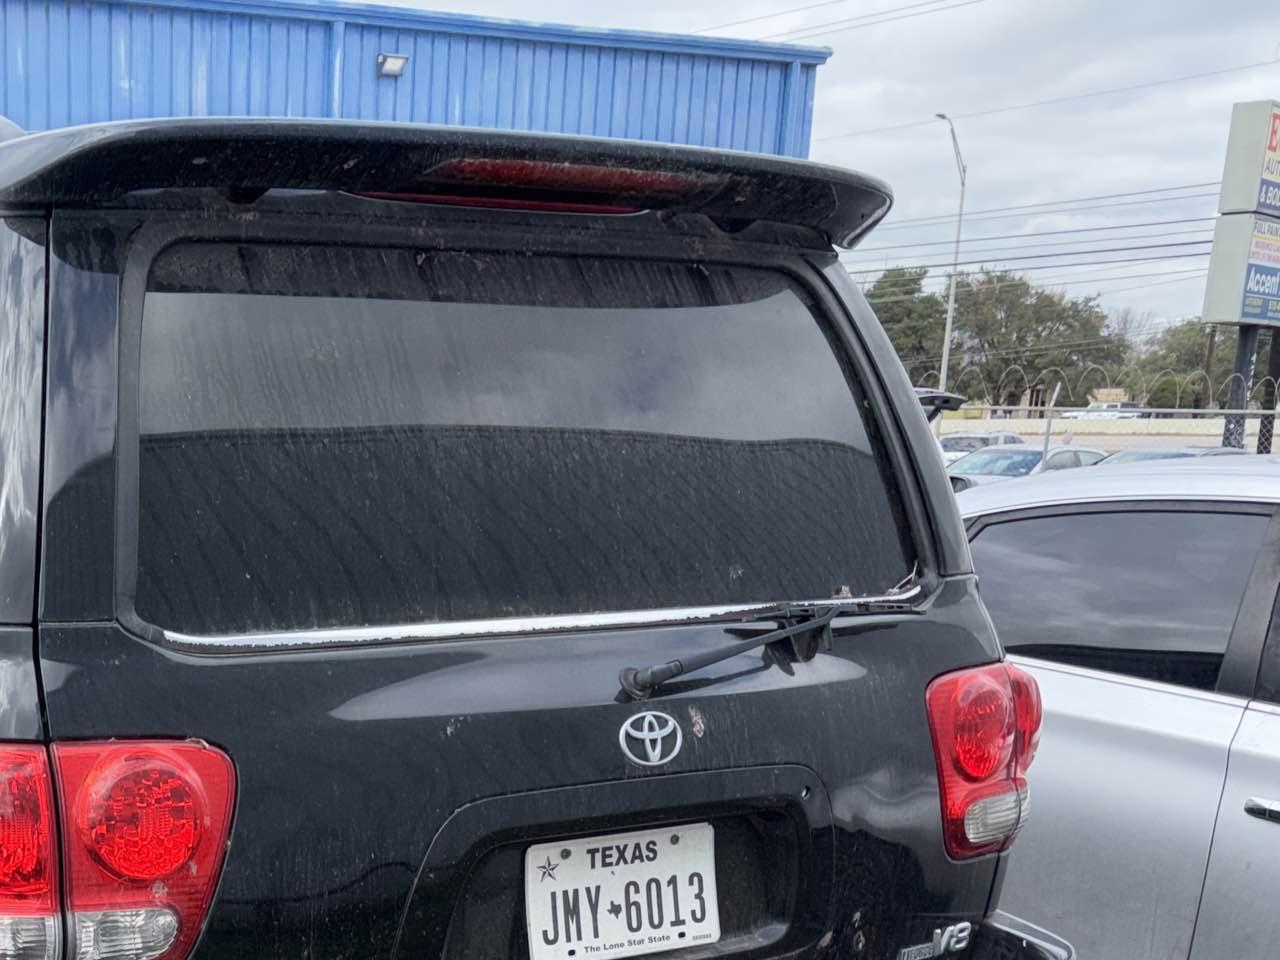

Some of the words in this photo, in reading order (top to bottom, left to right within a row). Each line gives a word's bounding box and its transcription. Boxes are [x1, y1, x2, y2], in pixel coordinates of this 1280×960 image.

[586, 840, 658, 870] TEXAS
[542, 885, 601, 946] JMY
[624, 872, 707, 933] 6013
[584, 945, 601, 954] The
[603, 942, 625, 951] Lone
[627, 938, 645, 947] Star
[648, 934, 671, 944] State
[933, 921, 971, 957] V8
